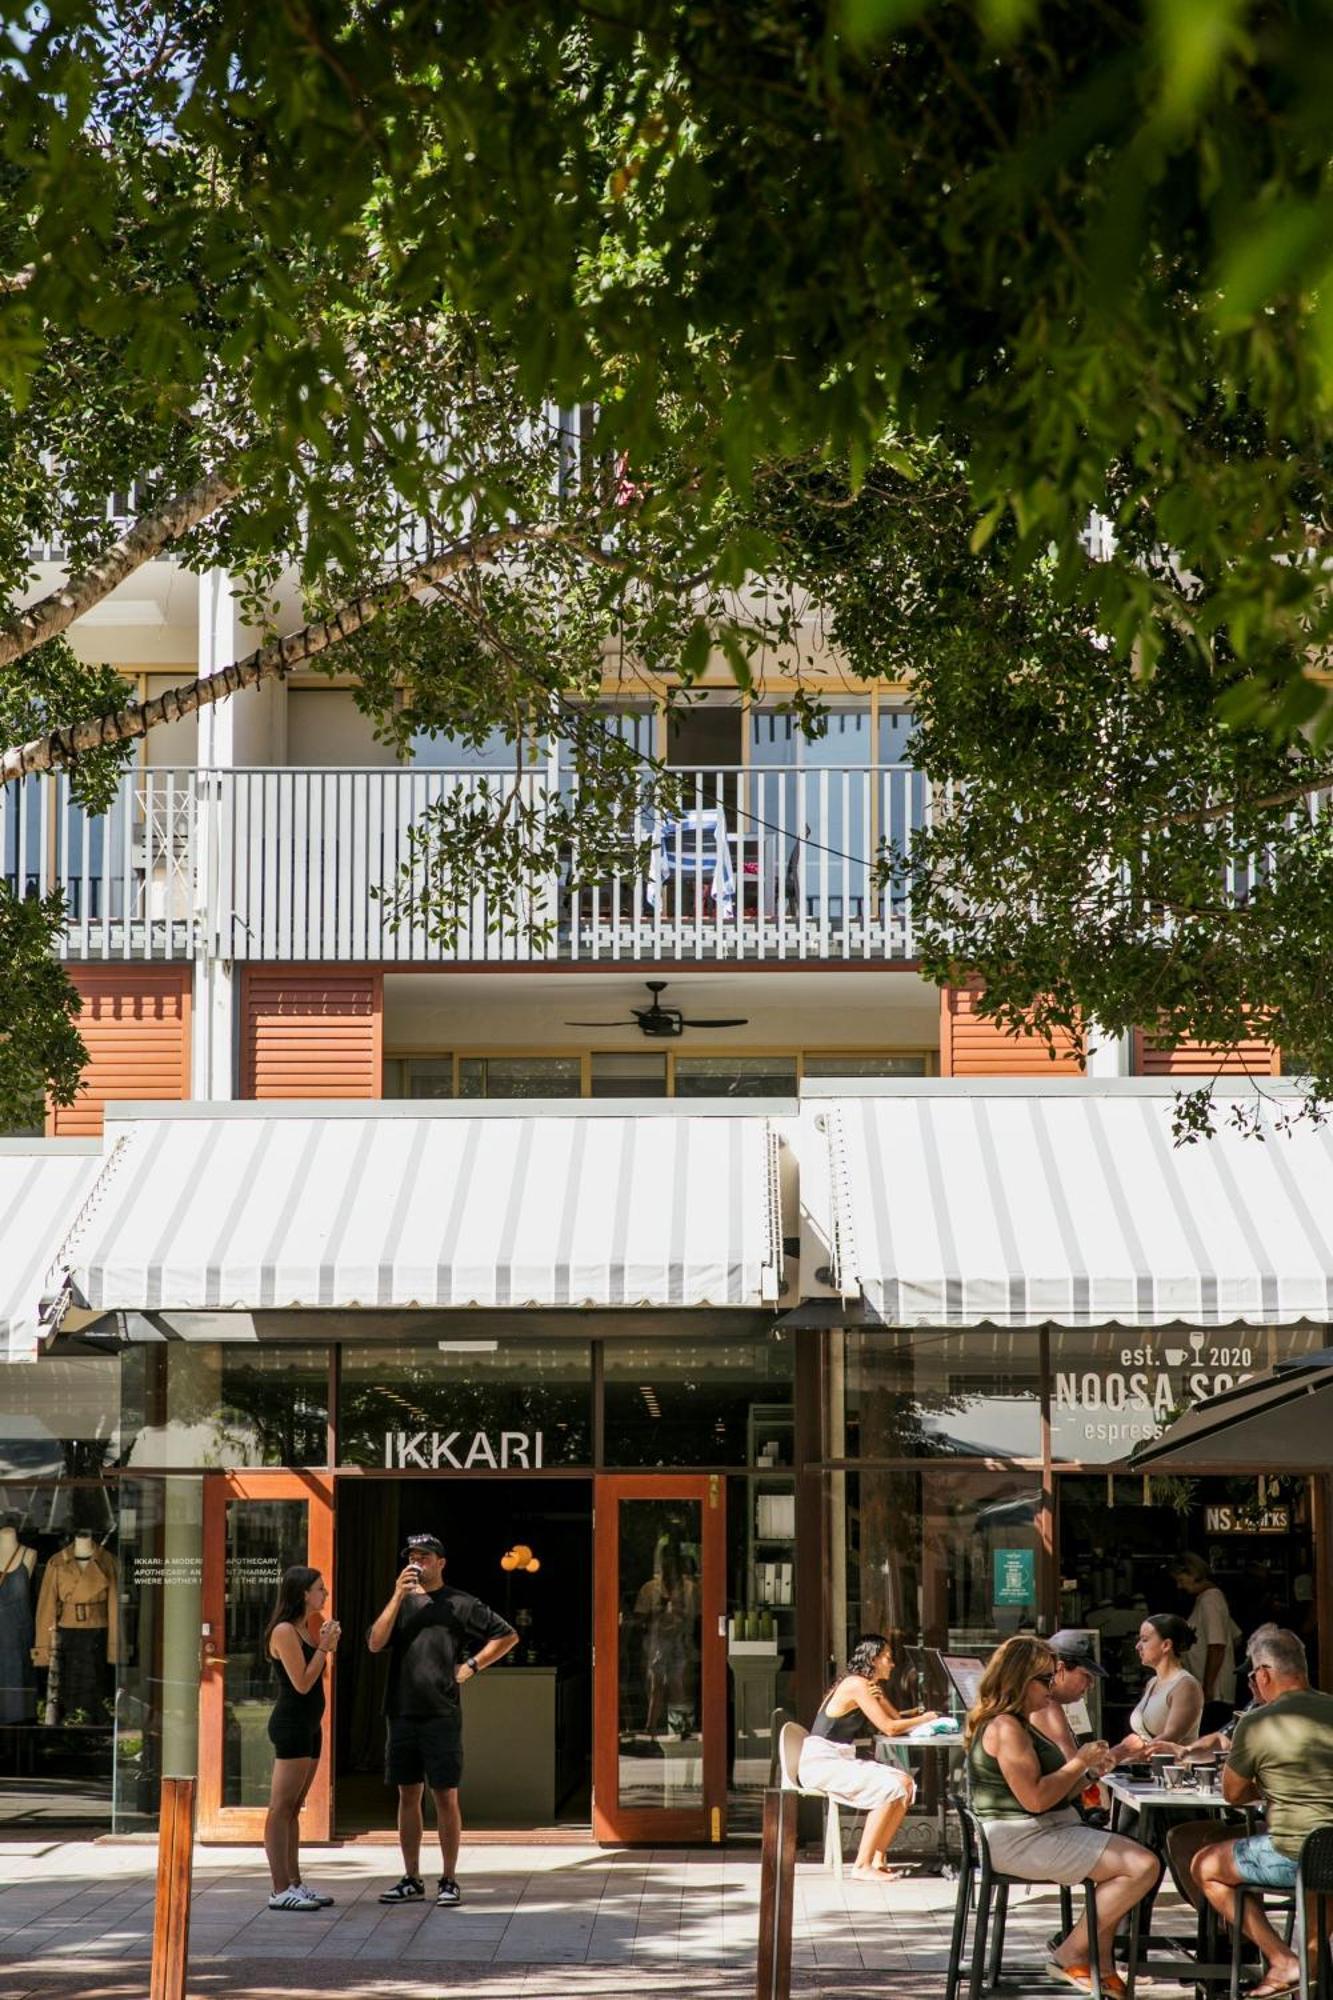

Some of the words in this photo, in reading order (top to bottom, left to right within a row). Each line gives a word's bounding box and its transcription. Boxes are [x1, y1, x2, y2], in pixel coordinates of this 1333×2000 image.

[1120, 1344, 1160, 1366] est.
[1210, 1348, 1251, 1366] 2020
[1055, 1373, 1174, 1411] NOOSA
[1189, 1373, 1254, 1405] SO
[385, 1431, 543, 1469] IKKARI
[1207, 1508, 1231, 1530] NS
